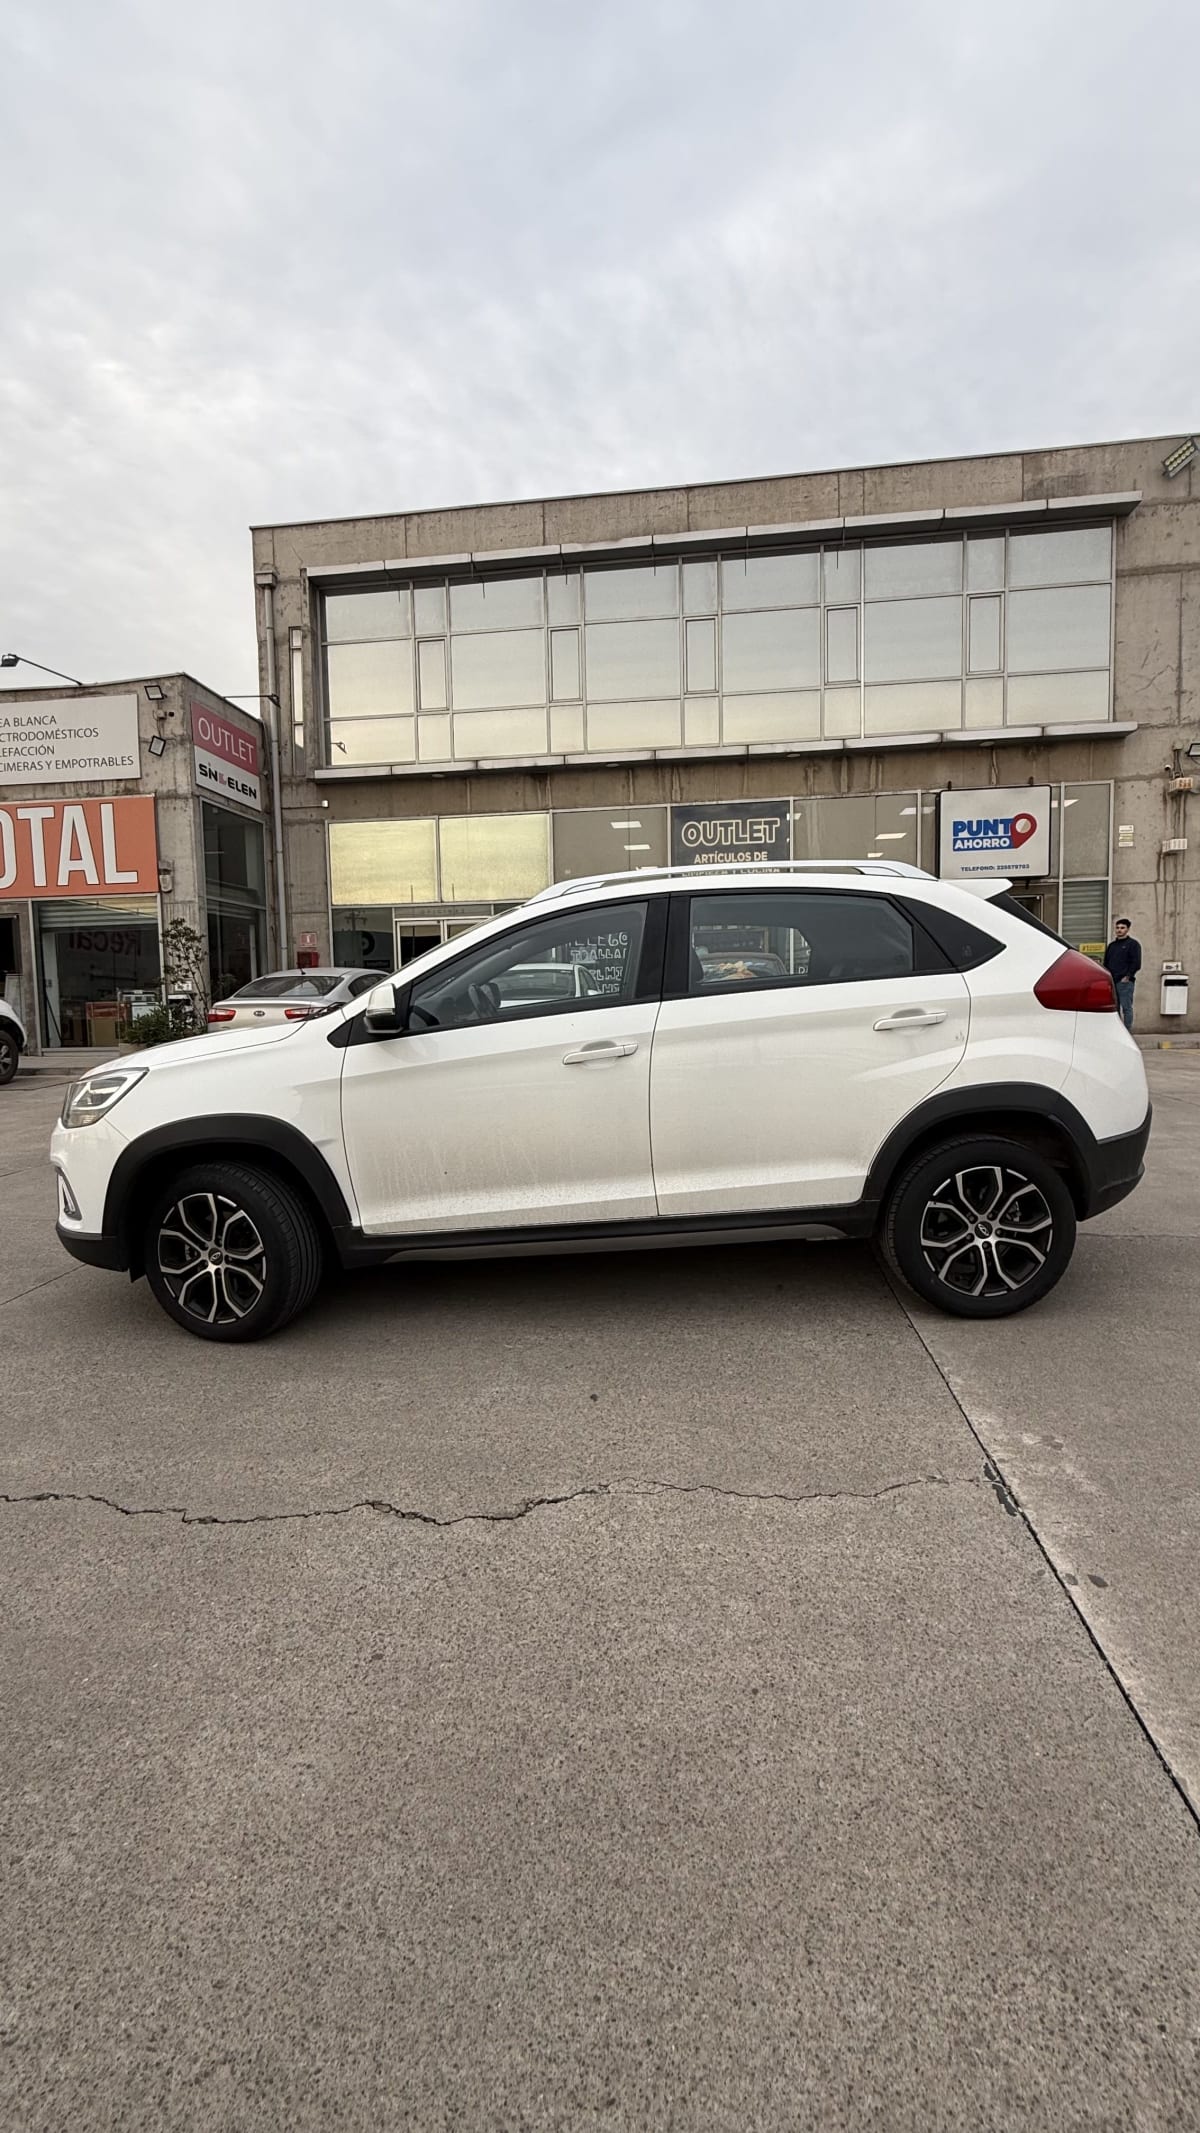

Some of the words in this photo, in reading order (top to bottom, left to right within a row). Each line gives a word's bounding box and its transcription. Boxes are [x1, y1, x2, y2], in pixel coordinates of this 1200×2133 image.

[13, 715, 57, 727] BLANCA
[198, 717, 254, 764] OUTLET
[0, 744, 55, 758] EFACCIÓN
[46, 761, 52, 770] Y
[55, 755, 134, 770] EMPOTRABLES
[681, 817, 780, 848] OUTLET
[954, 837, 1010, 850] AHORRO
[694, 851, 752, 864] ARTÍCULOS
[754, 851, 768, 861] DE
